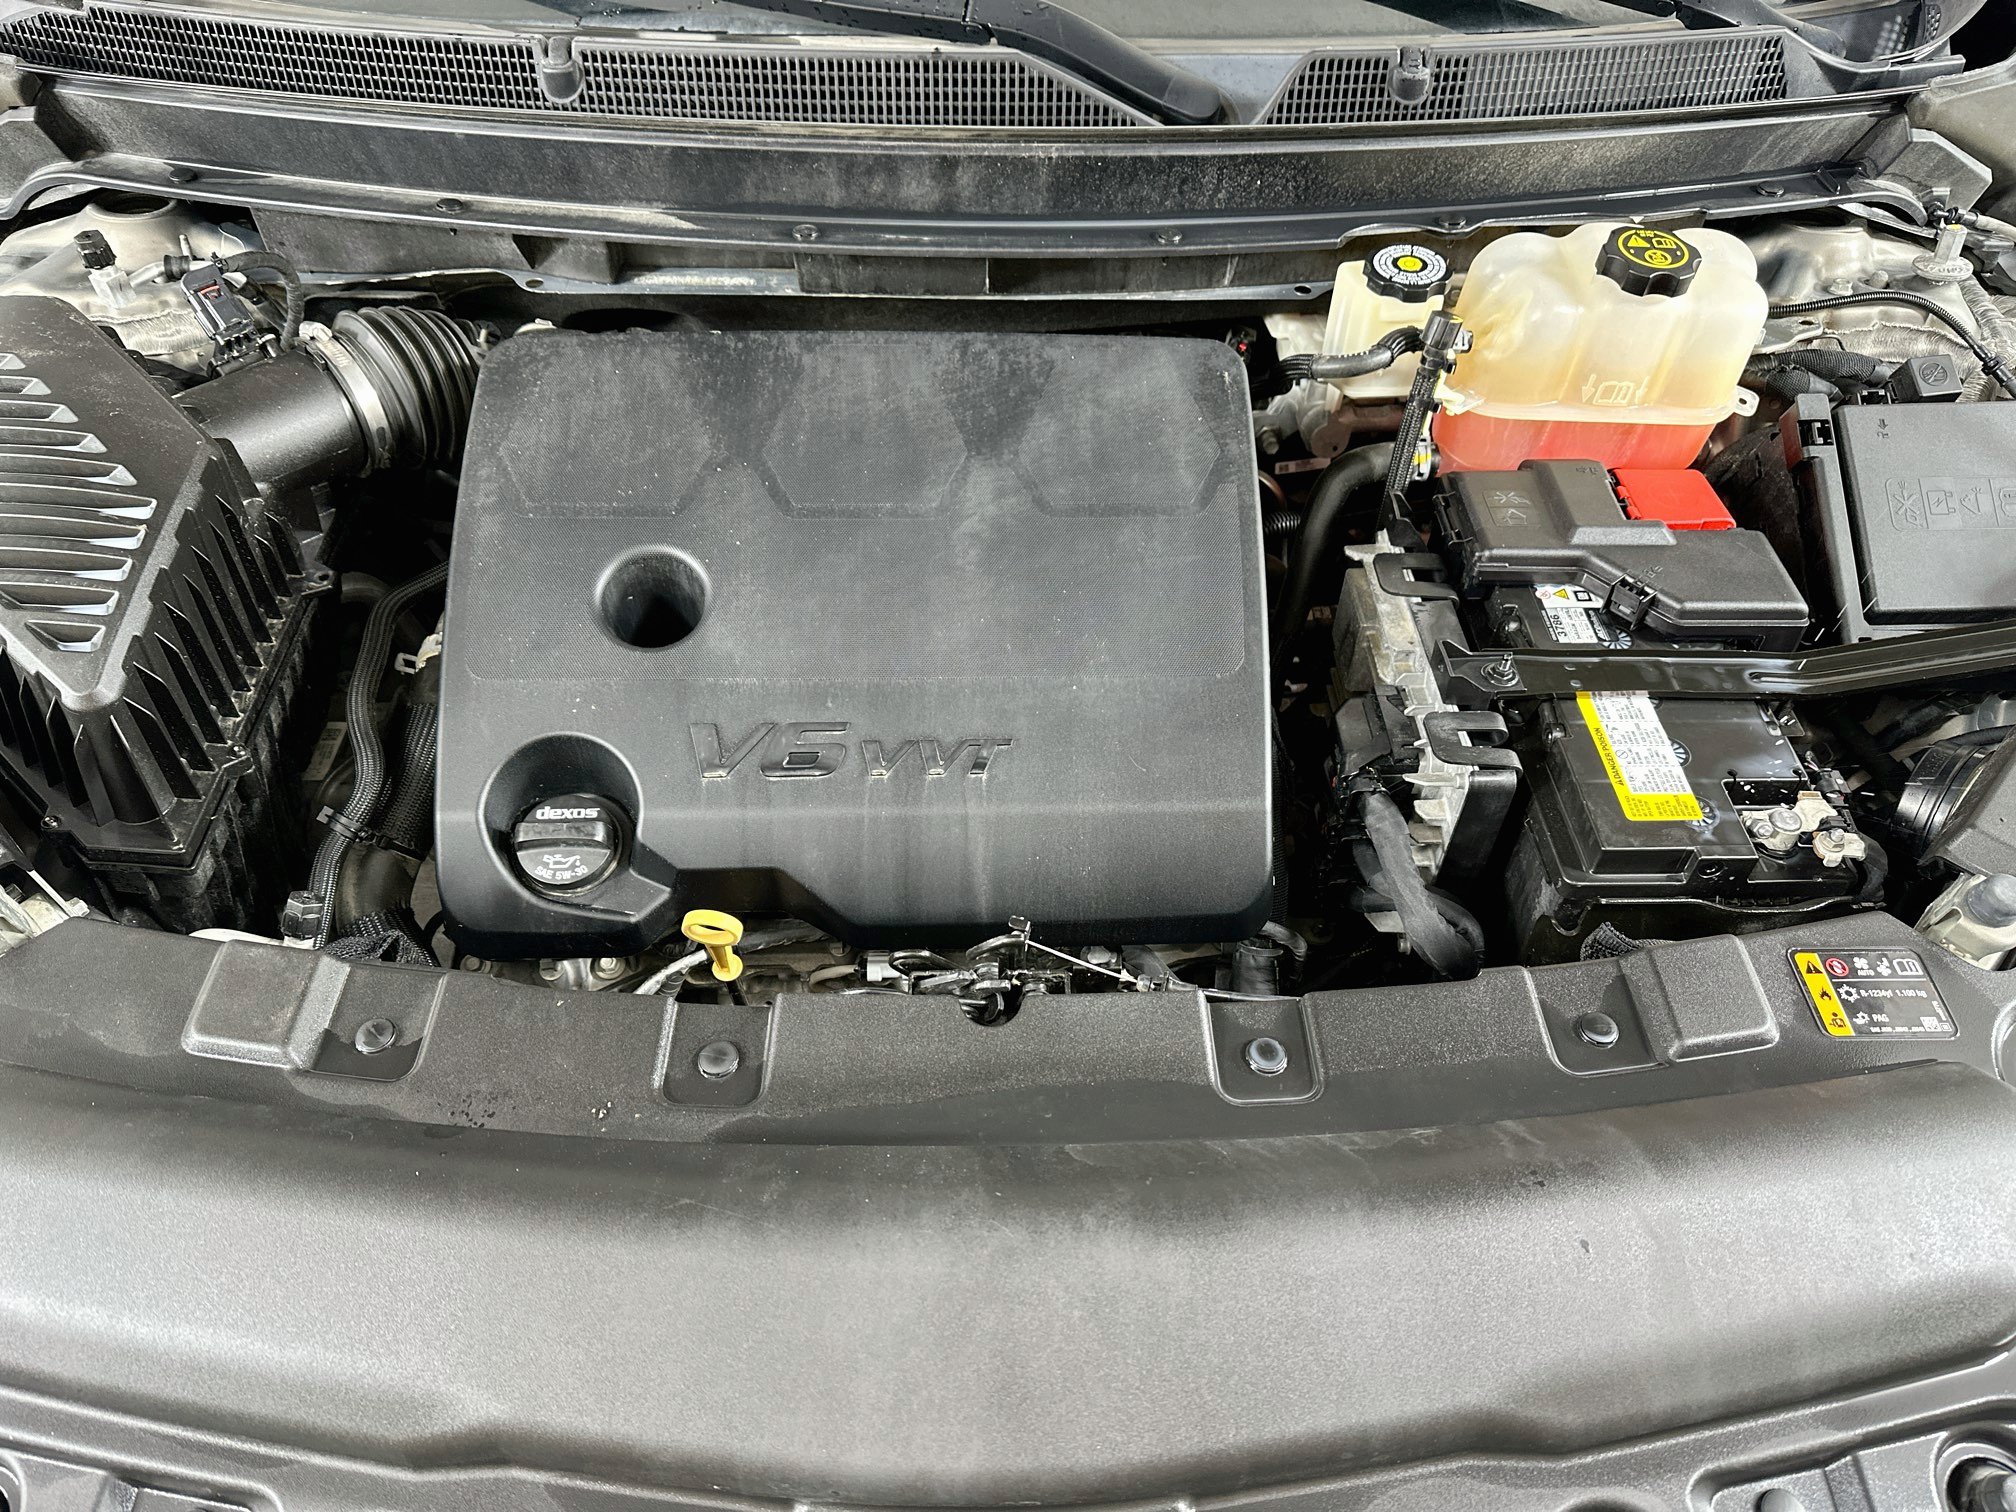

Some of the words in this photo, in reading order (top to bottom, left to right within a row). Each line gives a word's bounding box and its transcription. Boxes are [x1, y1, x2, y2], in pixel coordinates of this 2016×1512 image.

[1550, 614, 1567, 637] 3786
[690, 721, 850, 778] V6
[1594, 727, 1607, 754] POISON
[1604, 753, 1622, 781] DANGER
[535, 806, 601, 820] dexos
[534, 865, 554, 879] SAE
[555, 865, 588, 880] 5W-30
[1895, 989, 1916, 998] 1.100
[1916, 989, 1928, 999] kg
[1871, 1013, 1890, 1023] PAG
